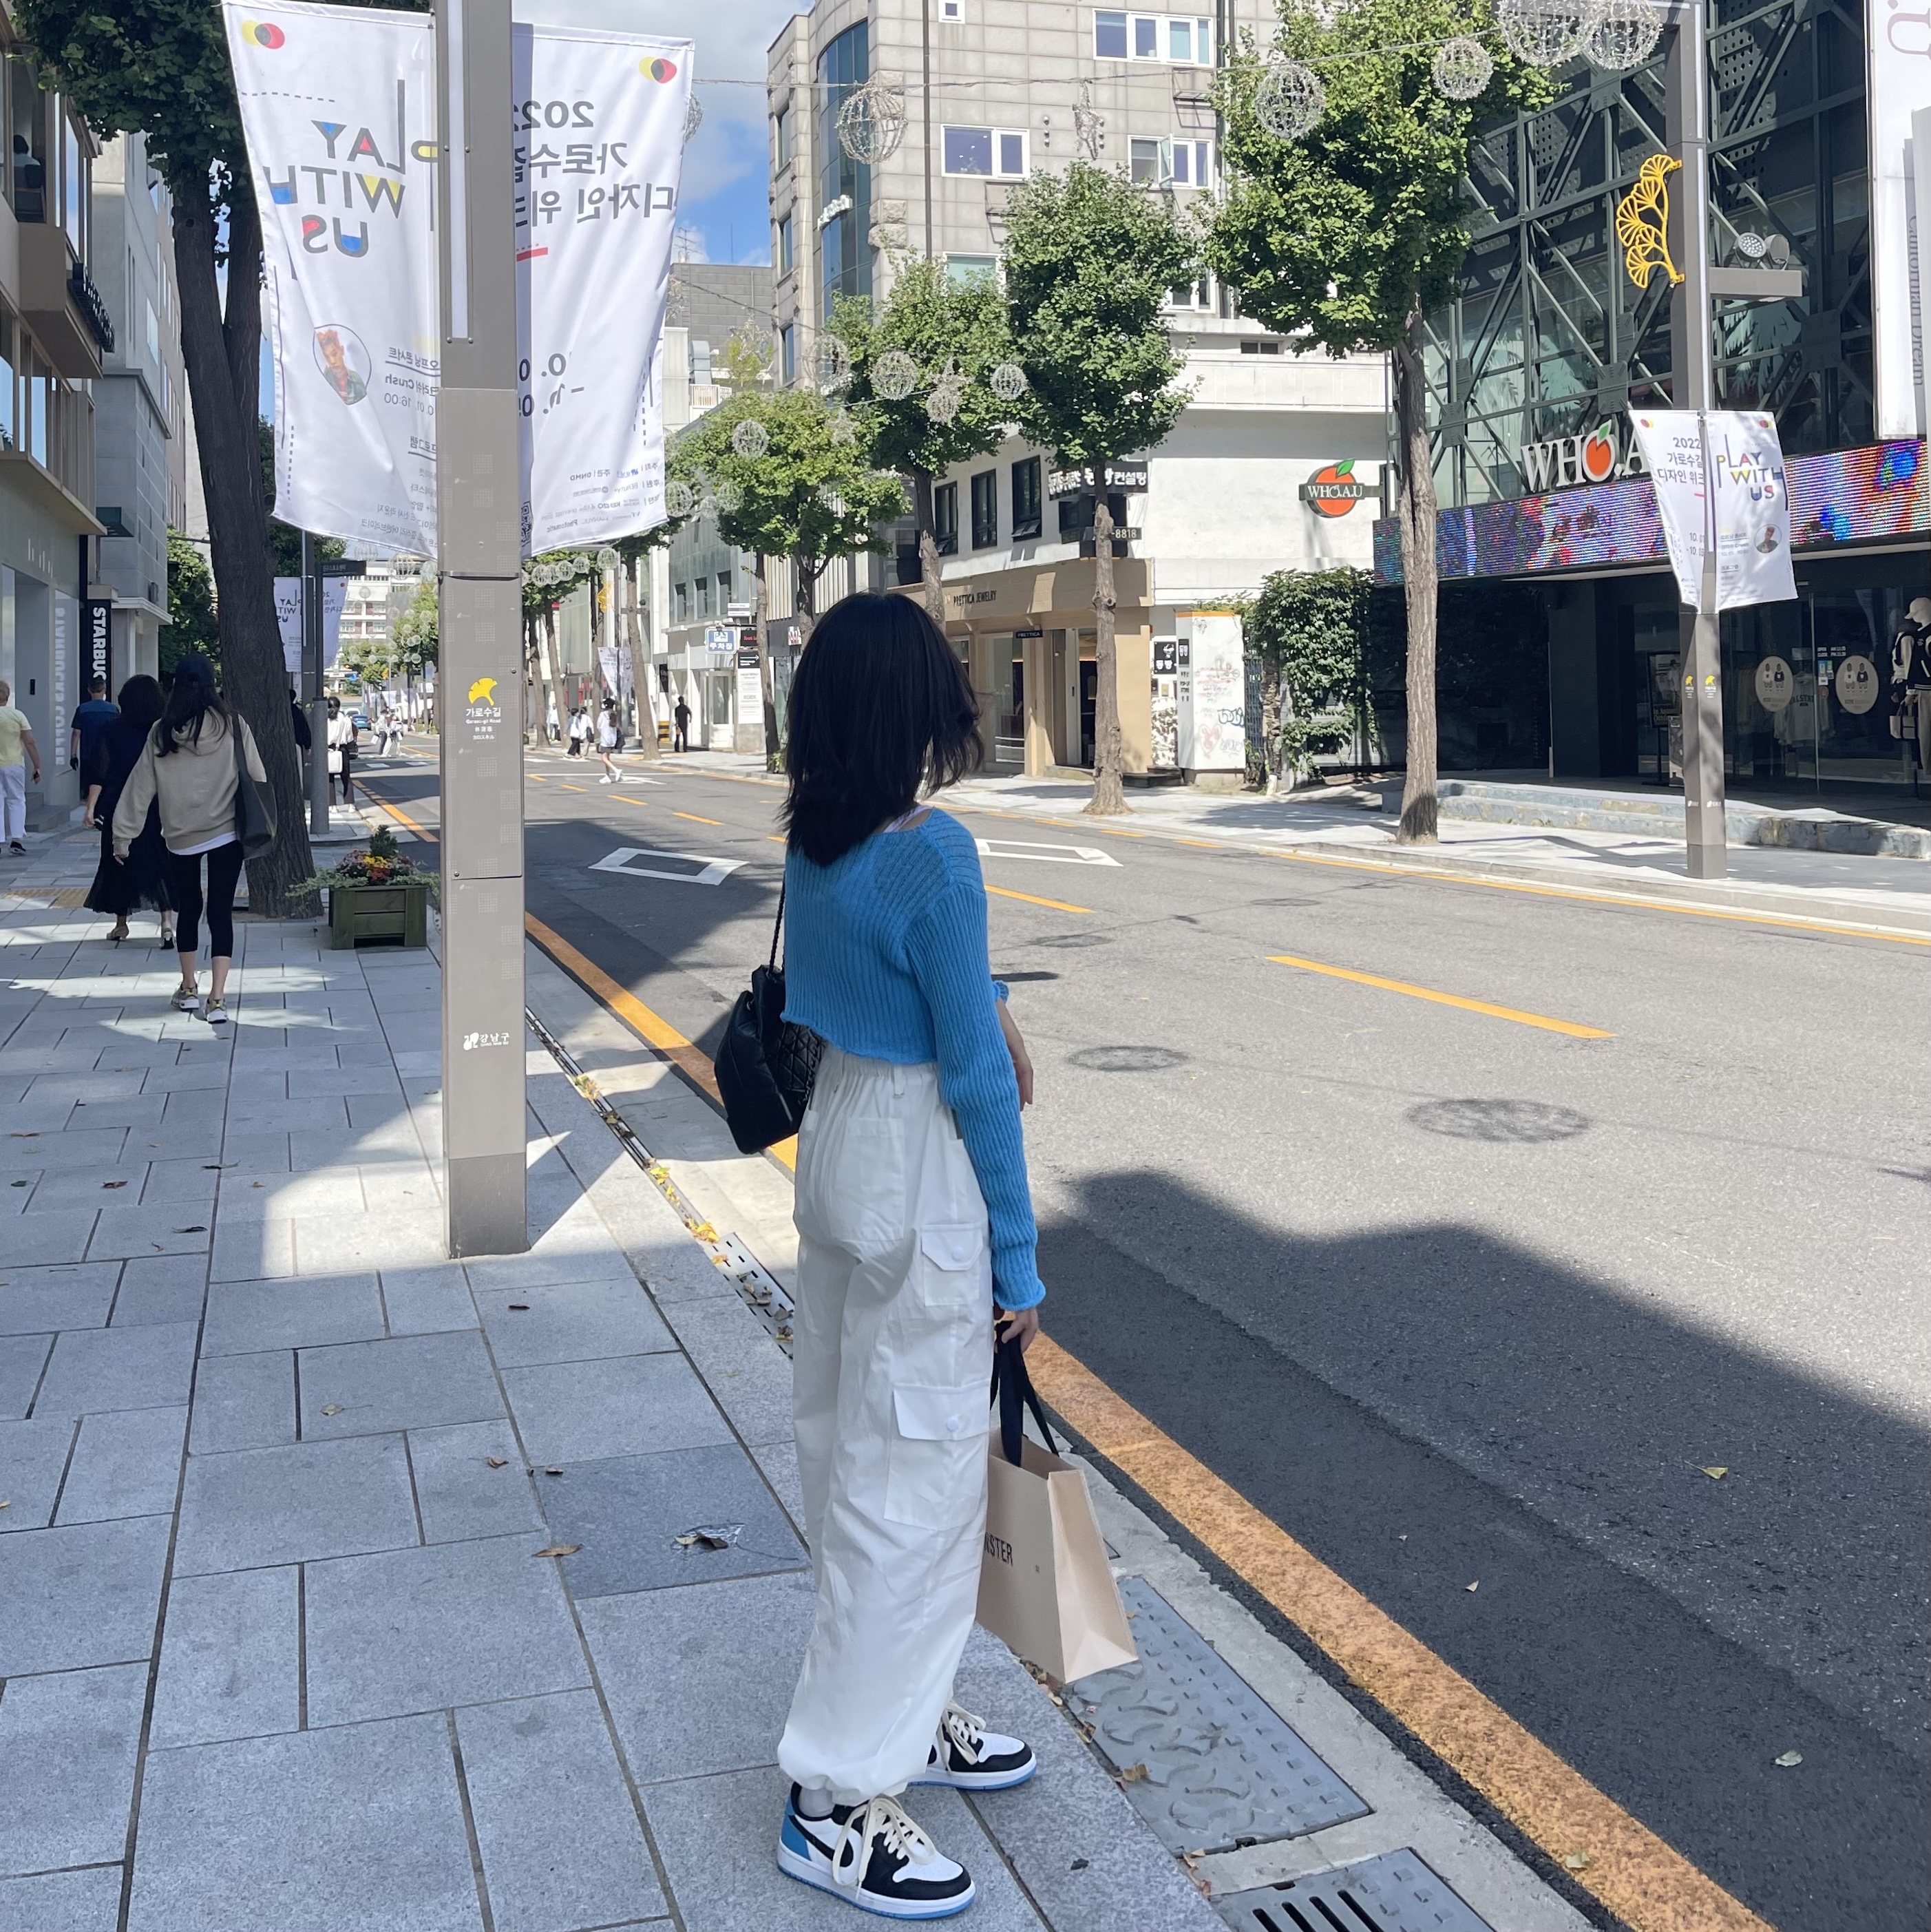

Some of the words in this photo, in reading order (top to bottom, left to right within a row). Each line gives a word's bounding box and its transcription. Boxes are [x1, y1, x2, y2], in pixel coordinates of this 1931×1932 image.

[1673, 437, 1701, 450] 2022
[1521, 419, 1651, 494] WHO.A
[1716, 434, 1761, 488] PLAY
[1658, 467, 1687, 483] 디자인
[1307, 484, 1363, 498] WHO.A.U
[1750, 485, 1775, 501] US
[976, 590, 997, 603] JEWELRY
[92, 606, 107, 682] STARBUC
[465, 706, 501, 718] 가로수길
[480, 1032, 510, 1043] 강남구
[984, 1531, 1013, 1567] NSTER
